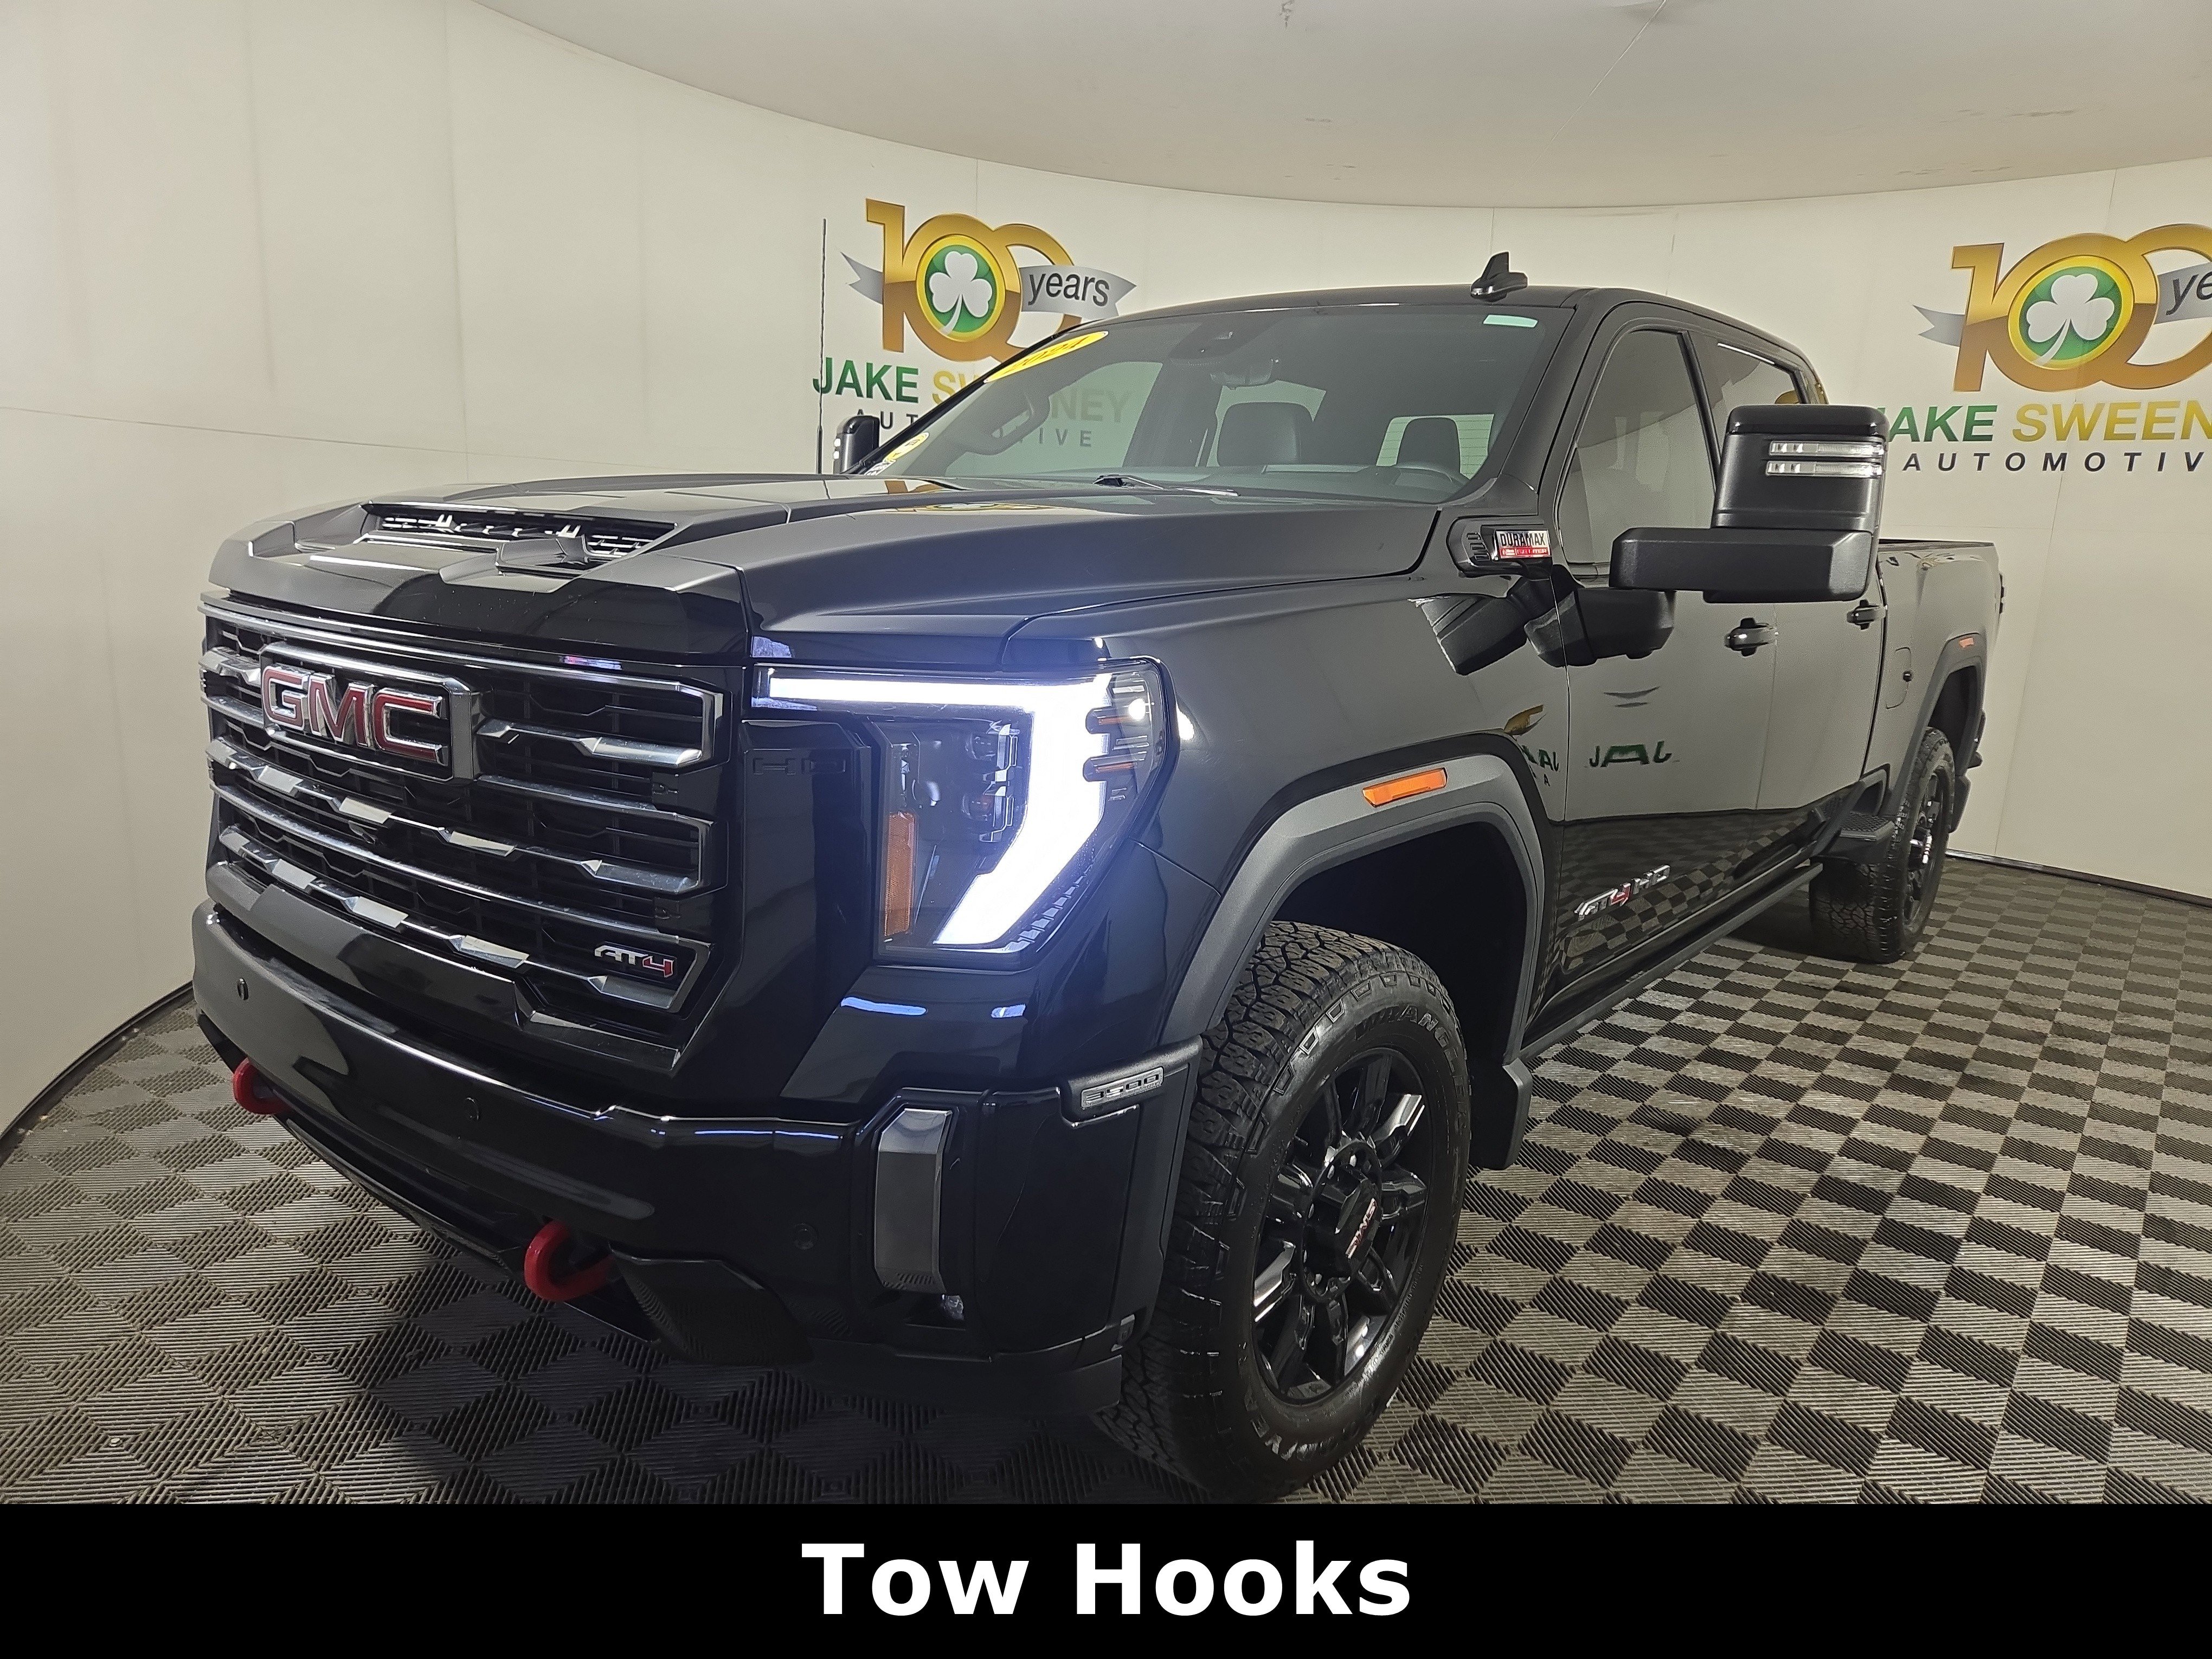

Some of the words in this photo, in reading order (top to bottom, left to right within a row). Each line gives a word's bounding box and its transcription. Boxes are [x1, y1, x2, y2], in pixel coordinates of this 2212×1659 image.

[865, 198, 1082, 362] 100
[1027, 273, 1110, 307] years
[813, 357, 918, 404] JAKE
[1879, 404, 1997, 442] AKE
[1902, 451, 2204, 472] AUTOMOTIV
[1500, 532, 1546, 546] DURAMAX
[261, 663, 448, 766] GMC
[594, 945, 674, 978] AT4
